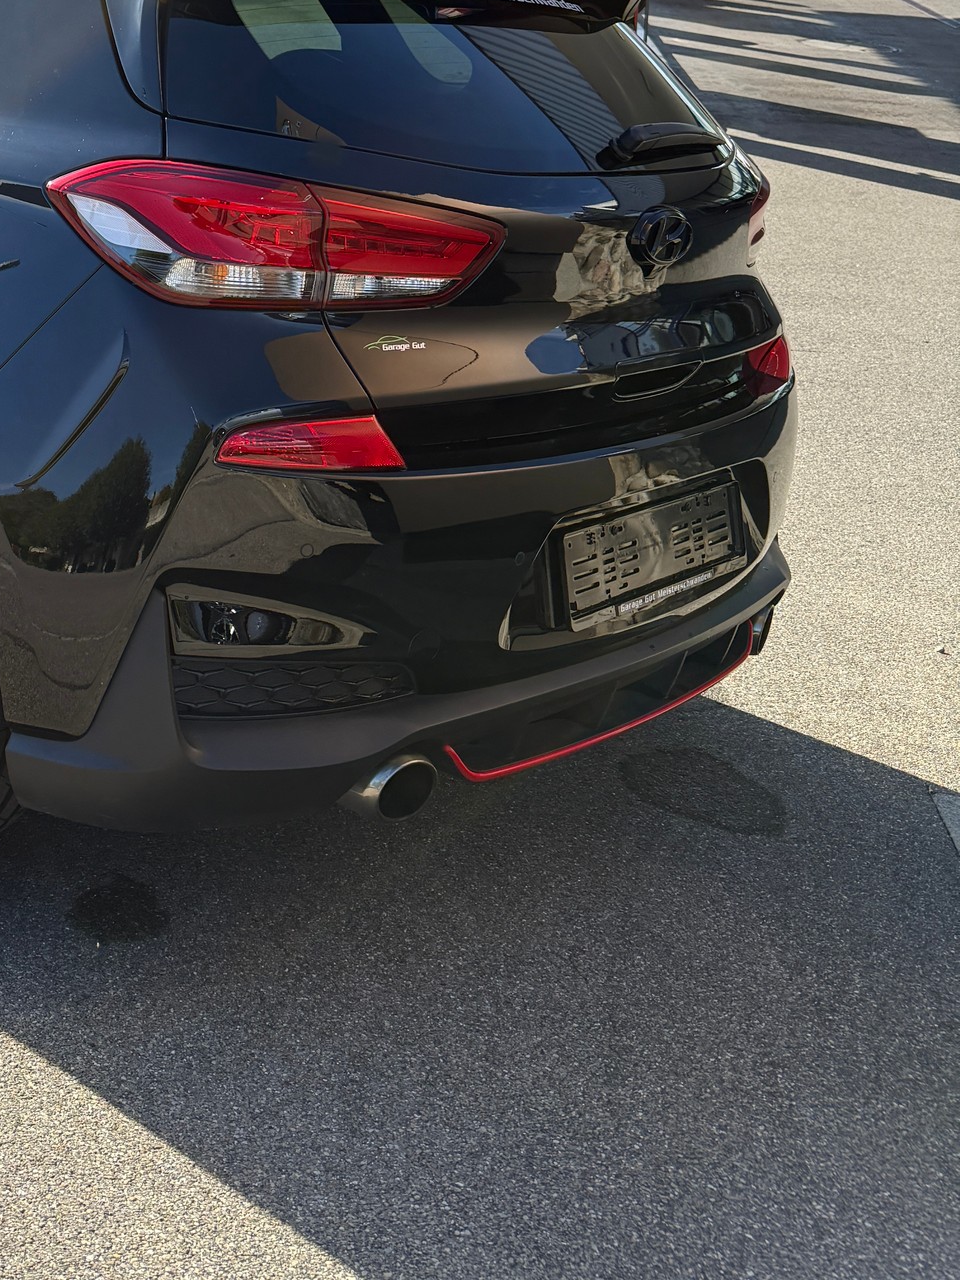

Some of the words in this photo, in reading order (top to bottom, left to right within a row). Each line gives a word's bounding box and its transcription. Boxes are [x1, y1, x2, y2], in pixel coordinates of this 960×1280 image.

[382, 343, 410, 351] Garage
[620, 600, 643, 613] Garage
[644, 593, 656, 603] Gut
[657, 572, 712, 598] Meisterschwanden
